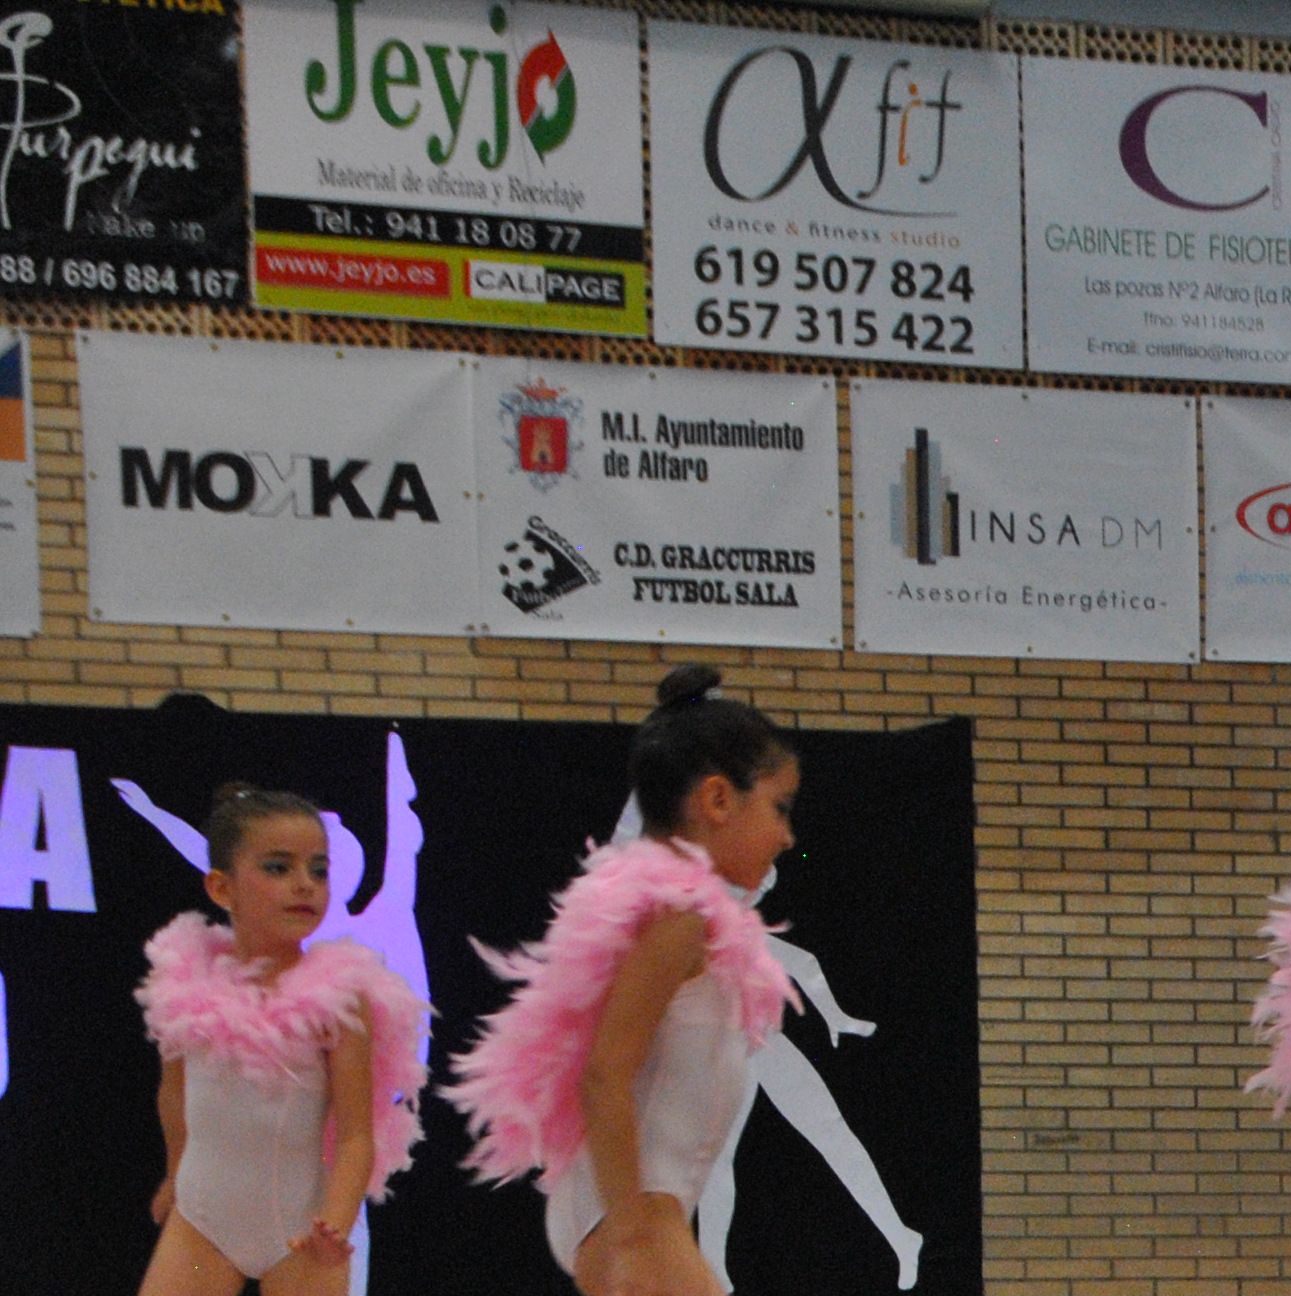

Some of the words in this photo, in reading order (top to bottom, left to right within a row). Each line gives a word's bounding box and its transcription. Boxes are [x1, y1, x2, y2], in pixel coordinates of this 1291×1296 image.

[1118, 85, 1270, 212] C
[317, 158, 397, 192] Material
[402, 166, 422, 193] de
[428, 169, 487, 199] oficina
[509, 175, 586, 213] Reciclaje
[309, 203, 373, 235] Tel.:
[386, 210, 440, 242] 941
[455, 217, 490, 246] 18
[500, 221, 536, 250] 08
[547, 226, 583, 252] 77
[708, 214, 777, 235] dance
[785, 221, 799, 236] &
[809, 221, 881, 242] fitness
[890, 230, 961, 248] studio
[1045, 224, 1157, 259] GABINETE
[1166, 231, 1196, 259] DE
[61, 259, 118, 291] 696
[123, 263, 179, 295] 884
[186, 268, 240, 298] 167
[266, 254, 436, 286] www.jeyjo.es
[475, 267, 622, 301] CALIPAGE
[694, 246, 780, 288] 619
[795, 253, 876, 294] 507
[890, 260, 974, 303] 824
[1085, 277, 1111, 295] Las
[1116, 281, 1163, 300] pozas
[1204, 283, 1250, 302] Alfaro
[1254, 287, 1277, 308] (La
[696, 298, 780, 339] 657
[796, 306, 878, 347] 315
[892, 312, 974, 354] 422
[602, 411, 647, 442] M.I.
[656, 414, 805, 451] Ayuntamiento
[604, 450, 629, 478] de
[638, 452, 708, 482] Alfaro
[970, 510, 1081, 547] INSA
[1102, 516, 1162, 550] DM
[614, 542, 656, 569] C.D.
[662, 546, 816, 575] GRACCURRIS
[632, 576, 731, 605] FUTBOL
[736, 581, 799, 608] SALA
